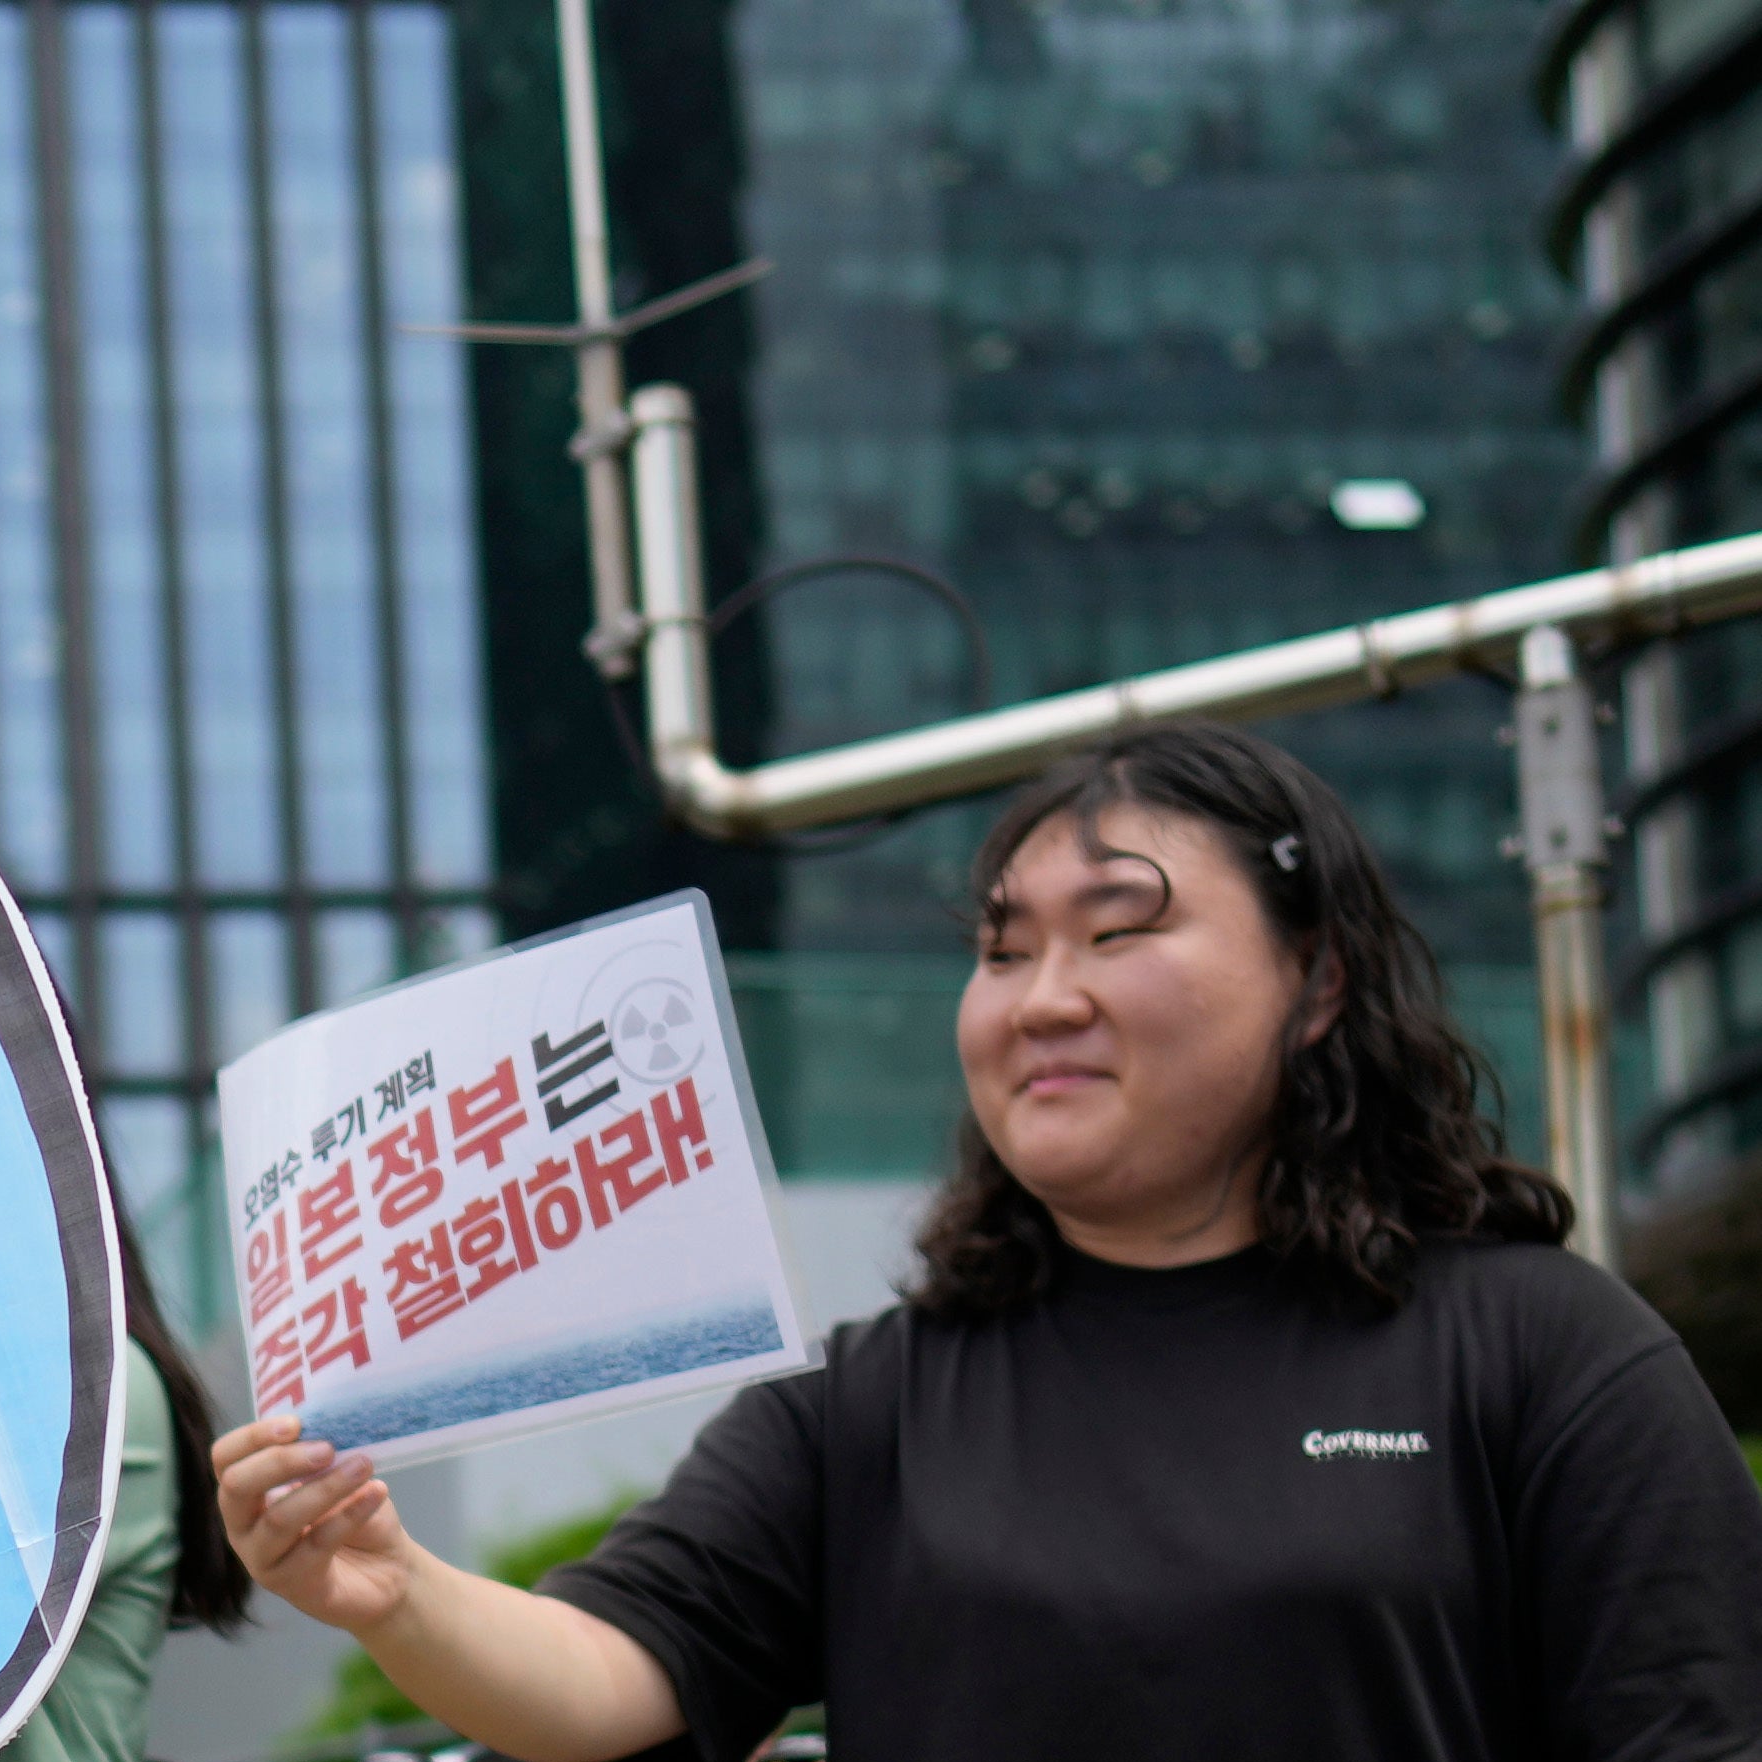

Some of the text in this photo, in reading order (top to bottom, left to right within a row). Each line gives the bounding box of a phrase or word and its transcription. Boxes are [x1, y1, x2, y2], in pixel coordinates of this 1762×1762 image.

[310, 1095, 367, 1163] 투기
[373, 1047, 437, 1123] 계획
[255, 1076, 717, 1417] 즉각 철회하라!
